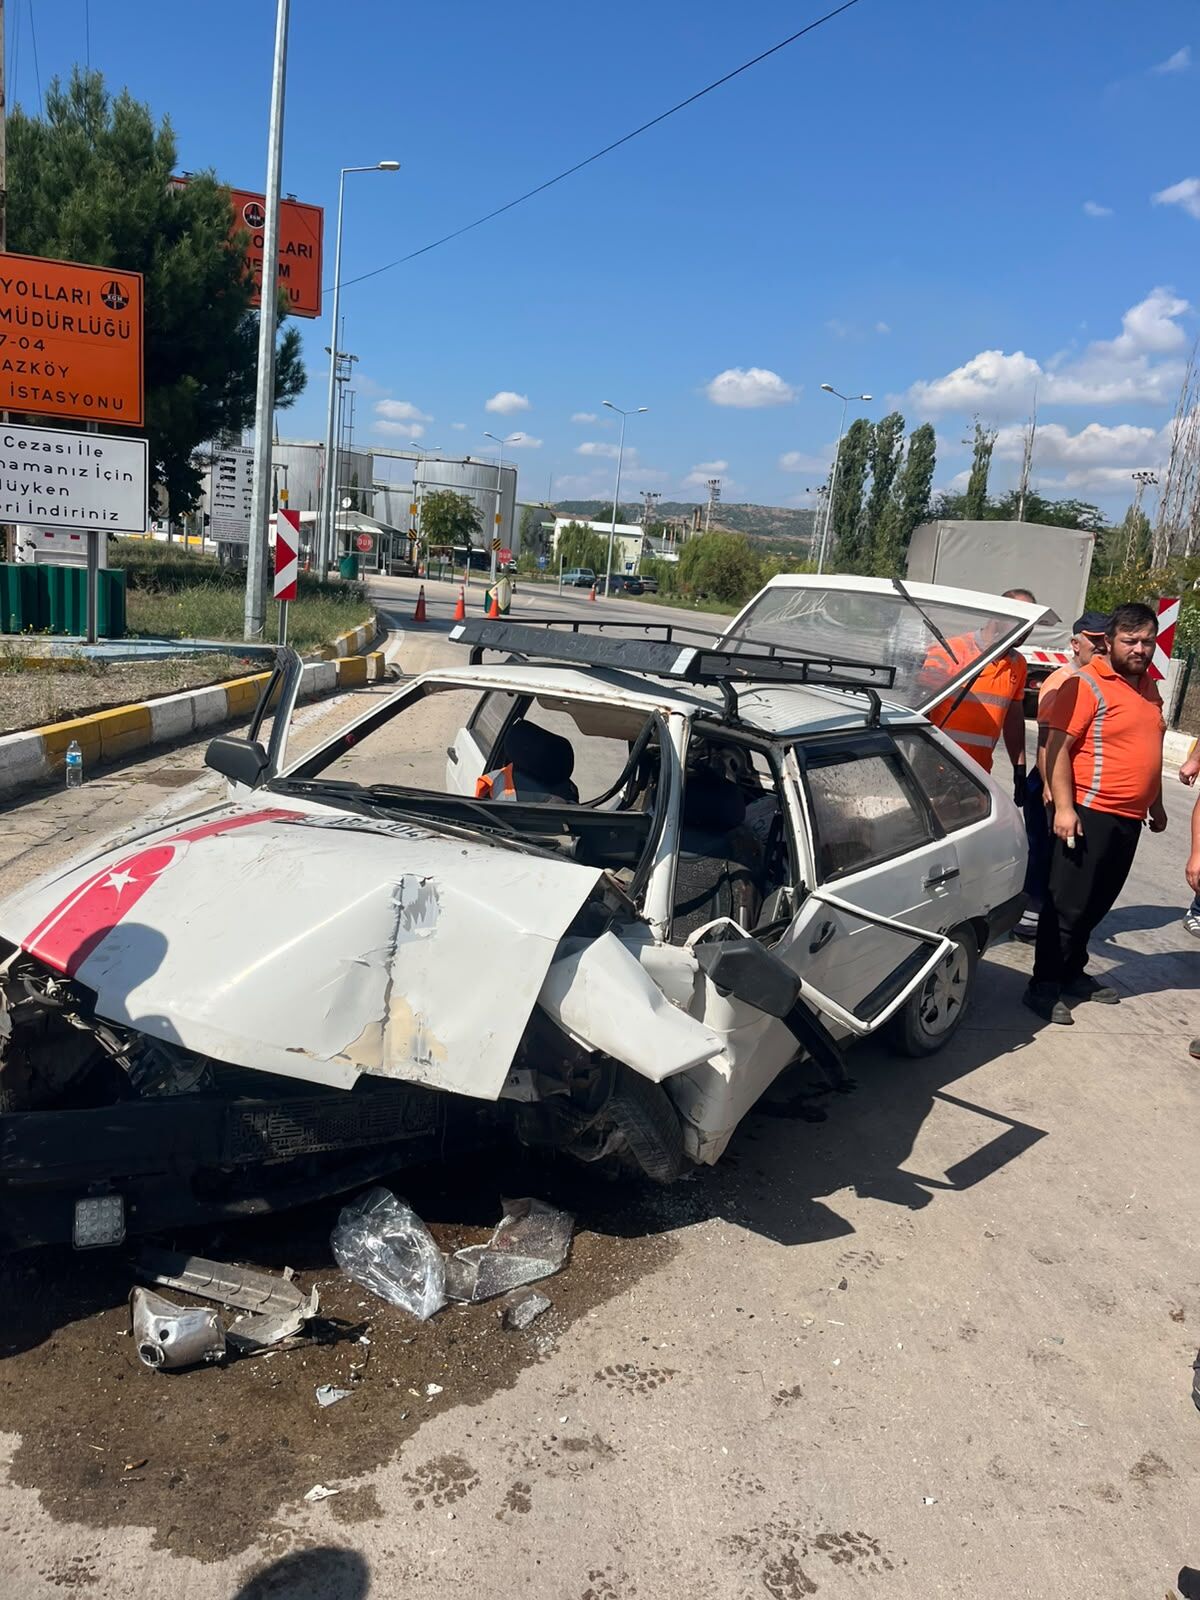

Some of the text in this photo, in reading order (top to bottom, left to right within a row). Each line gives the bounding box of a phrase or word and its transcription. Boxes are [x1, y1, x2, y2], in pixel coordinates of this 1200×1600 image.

[0, 277, 91, 306] YOLLARI
[0, 305, 131, 339] MÜDÜRLÜĞÜ
[2, 359, 70, 378] AZKÖY
[10, 381, 124, 410] İSTASYONU
[4, 435, 103, 457] Cezası İle
[96, 463, 133, 481] İçin
[28, 499, 119, 520] İndiriniz
